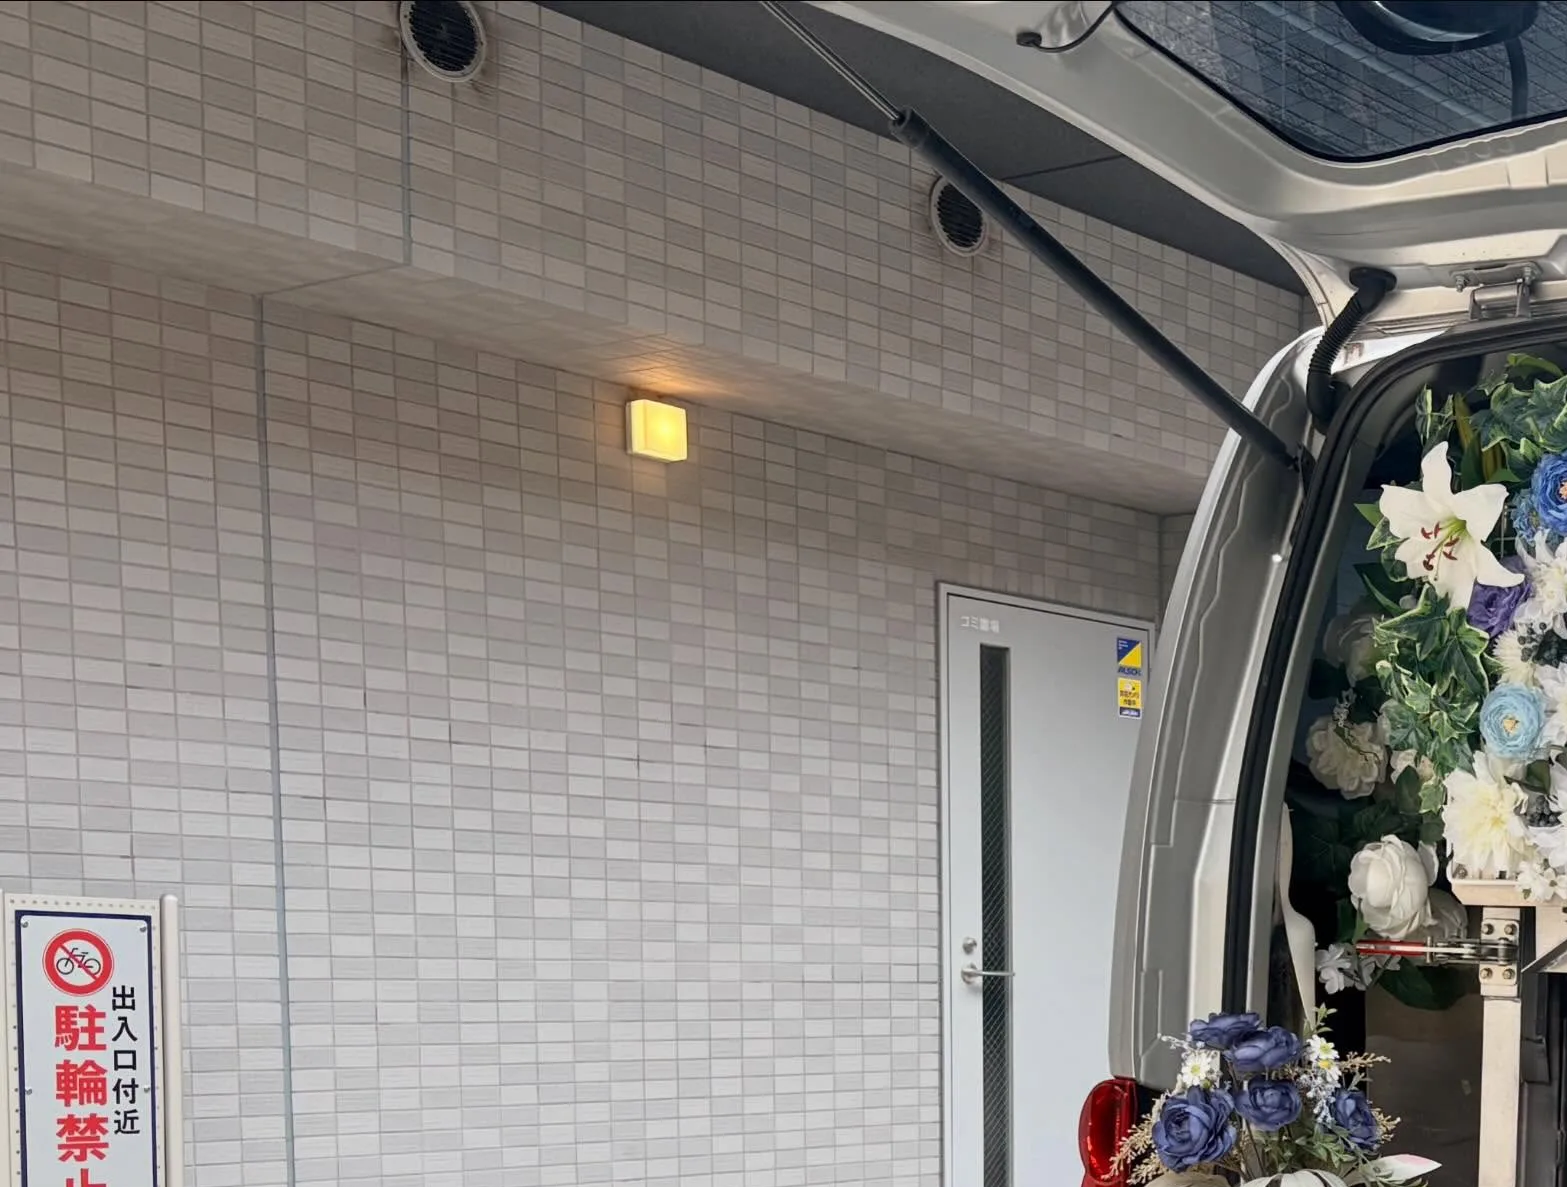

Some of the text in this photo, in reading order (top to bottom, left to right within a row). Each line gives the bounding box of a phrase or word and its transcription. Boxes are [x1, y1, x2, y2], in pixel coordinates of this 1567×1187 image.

[112, 985, 140, 1135] 出入口付近
